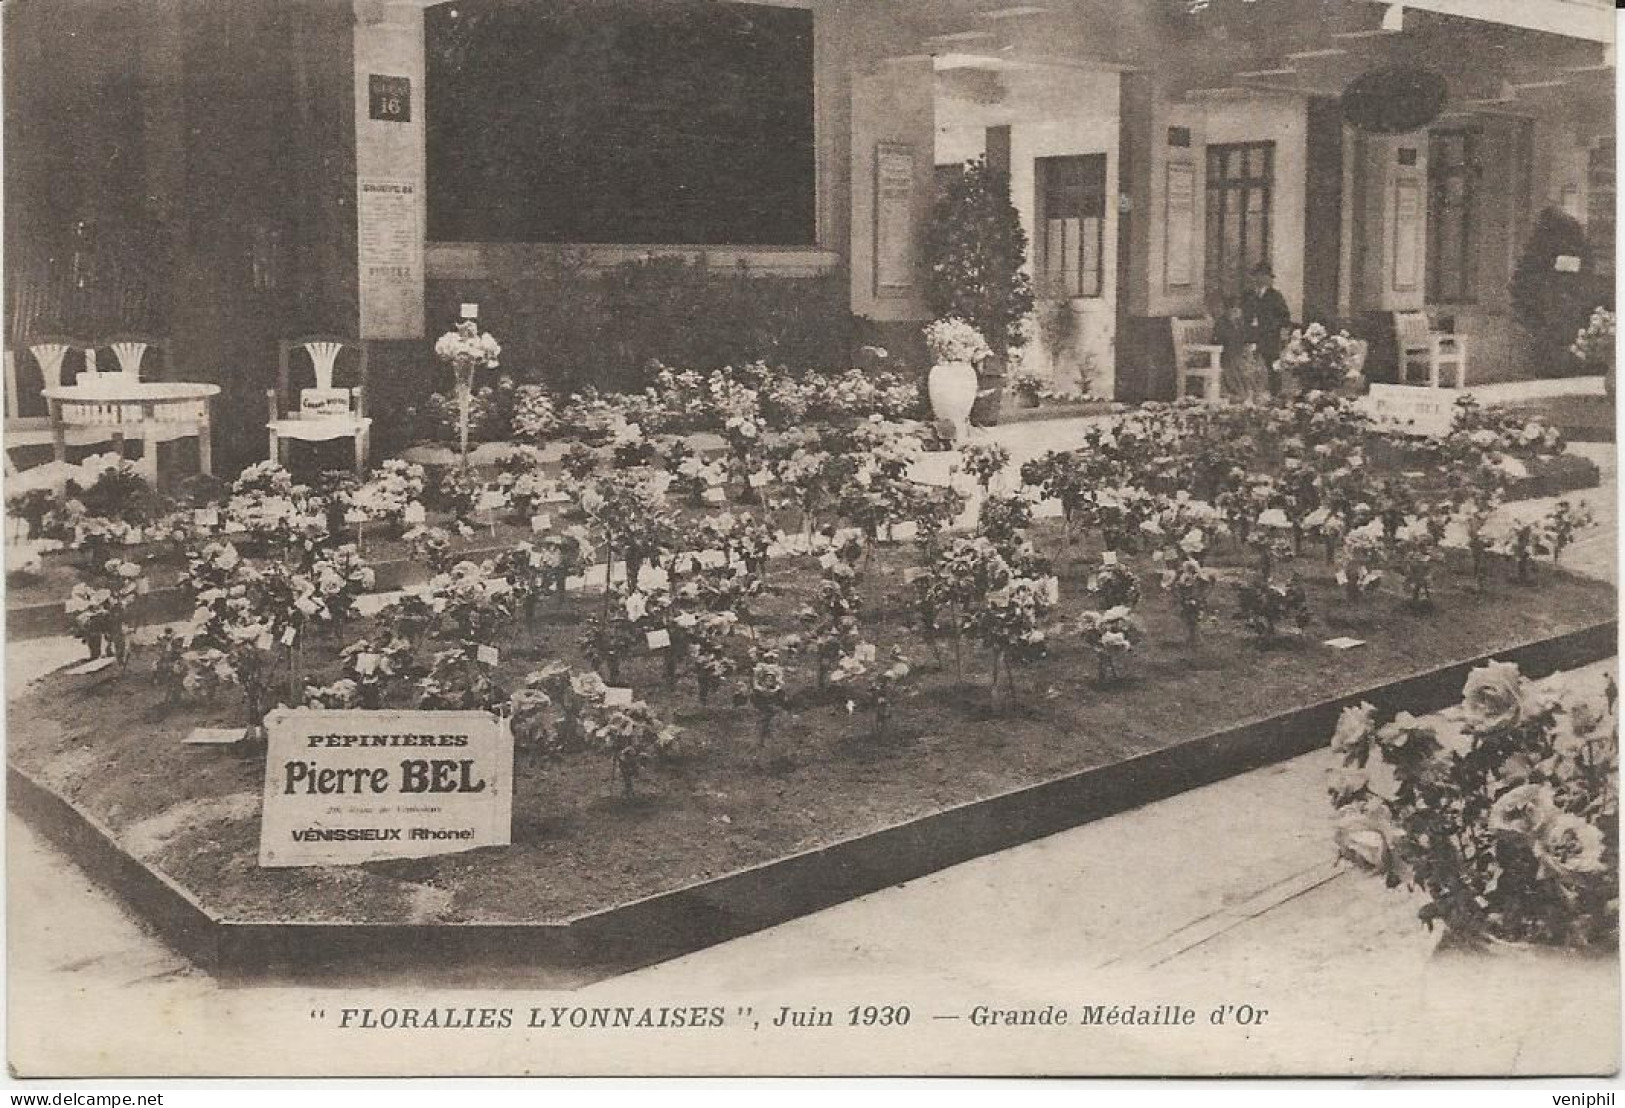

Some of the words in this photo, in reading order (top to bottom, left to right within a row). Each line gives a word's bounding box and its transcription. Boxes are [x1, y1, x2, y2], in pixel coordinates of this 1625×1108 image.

[380, 97, 401, 114] 16
[308, 732, 469, 748] PÉPINIÈRES
[284, 761, 389, 794] Pierre
[399, 759, 486, 794] BEL
[292, 827, 402, 842] VÉNISSIEUX
